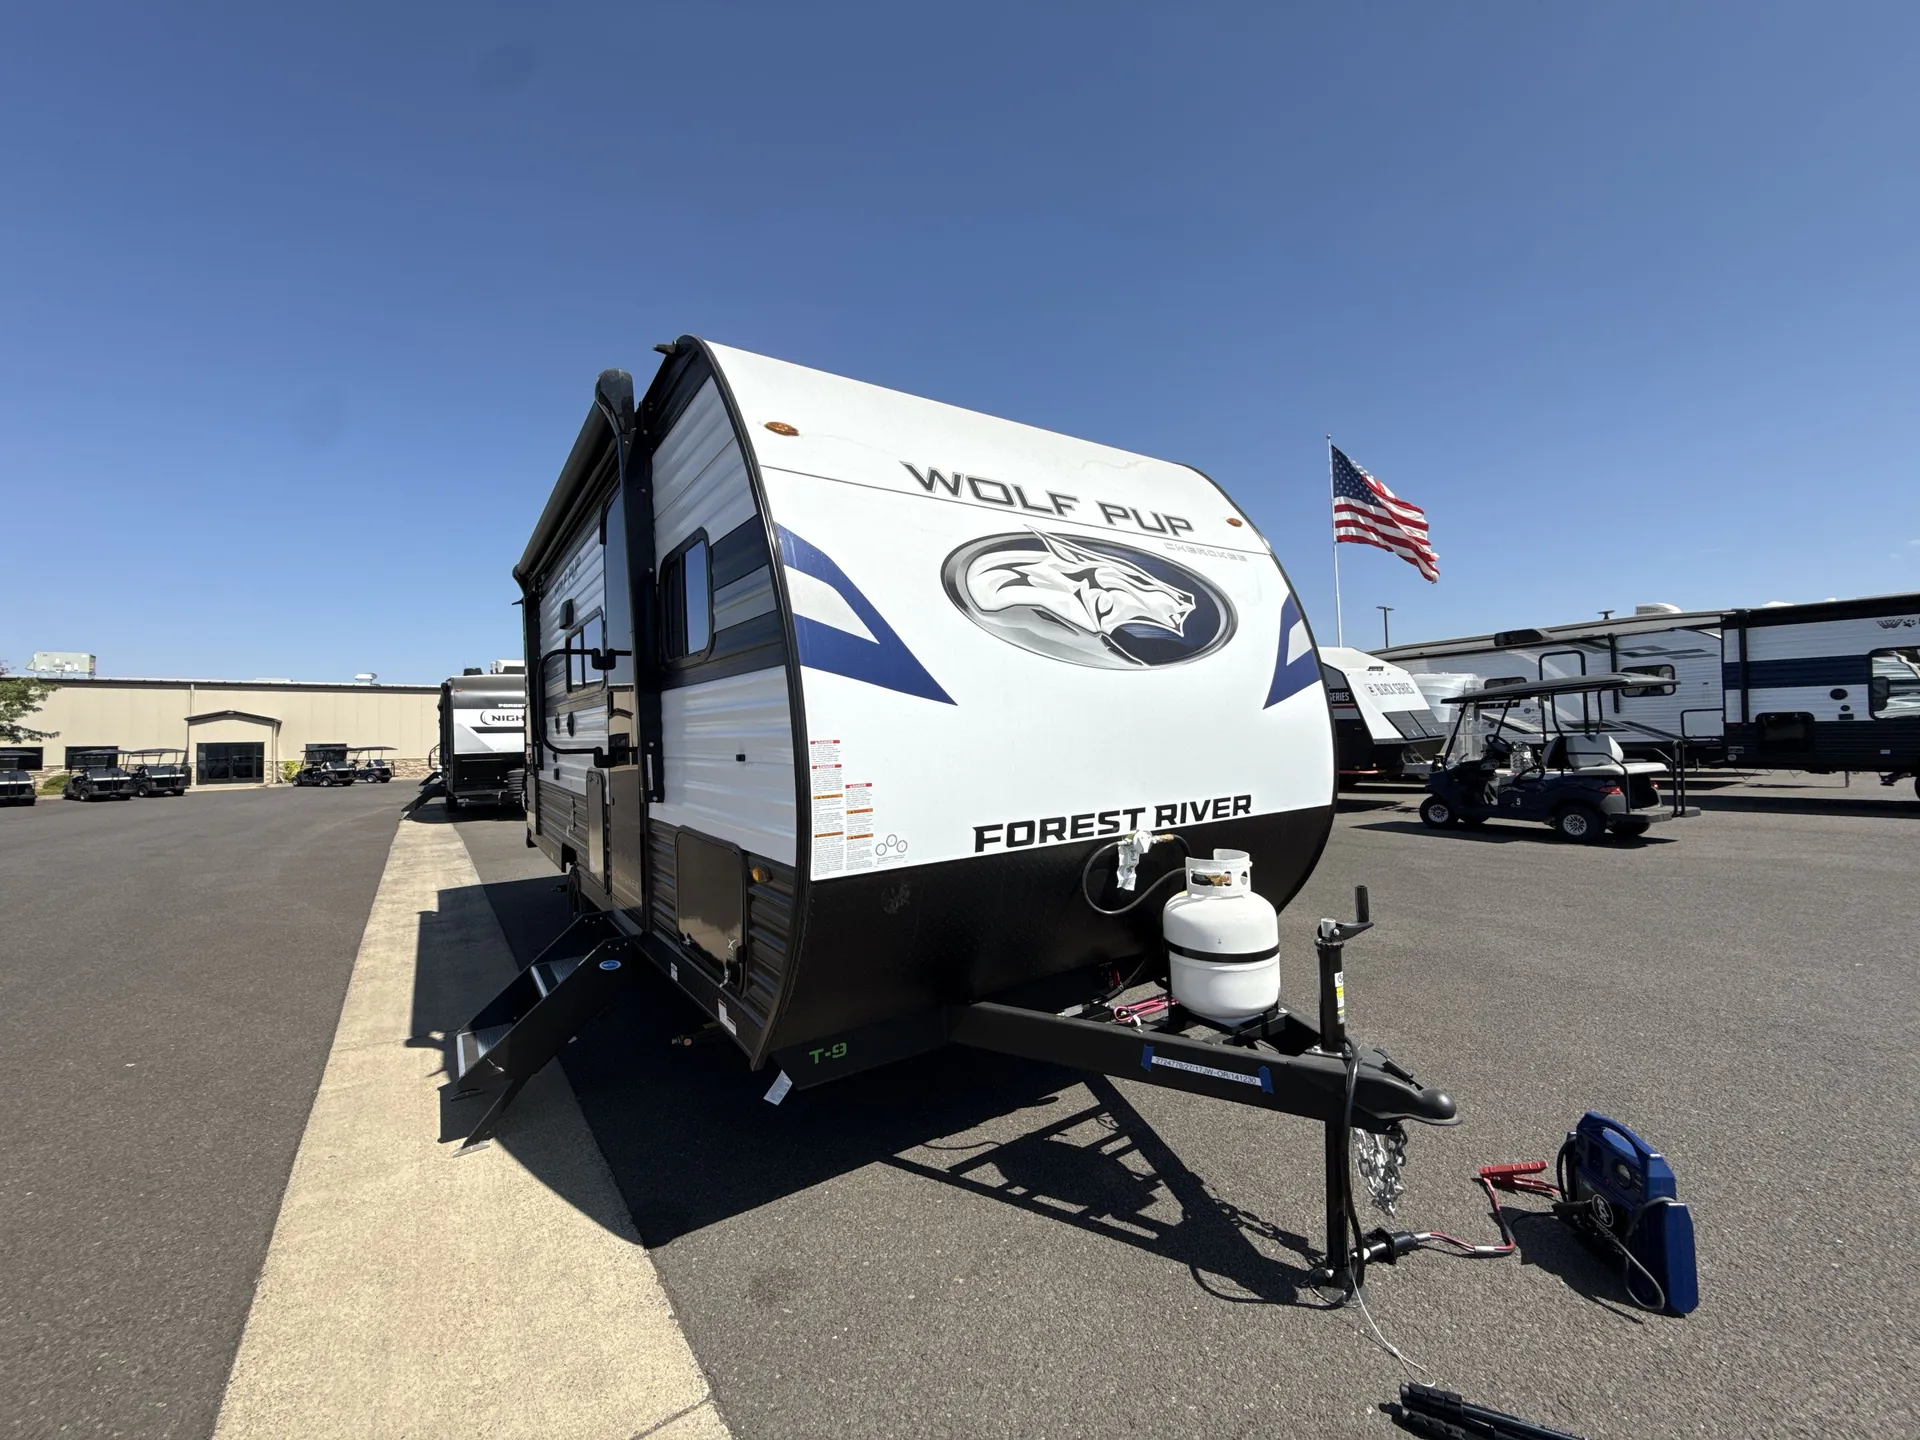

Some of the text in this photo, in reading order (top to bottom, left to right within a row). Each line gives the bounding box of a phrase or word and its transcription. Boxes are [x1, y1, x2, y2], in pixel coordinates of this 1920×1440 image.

[899, 461, 1194, 537] WOLF PUP
[1163, 542, 1248, 563] CHEROKEE
[1392, 682, 1415, 695] SERIES
[972, 794, 1252, 853] FOREST RIVER
[808, 1042, 848, 1065] T-9
